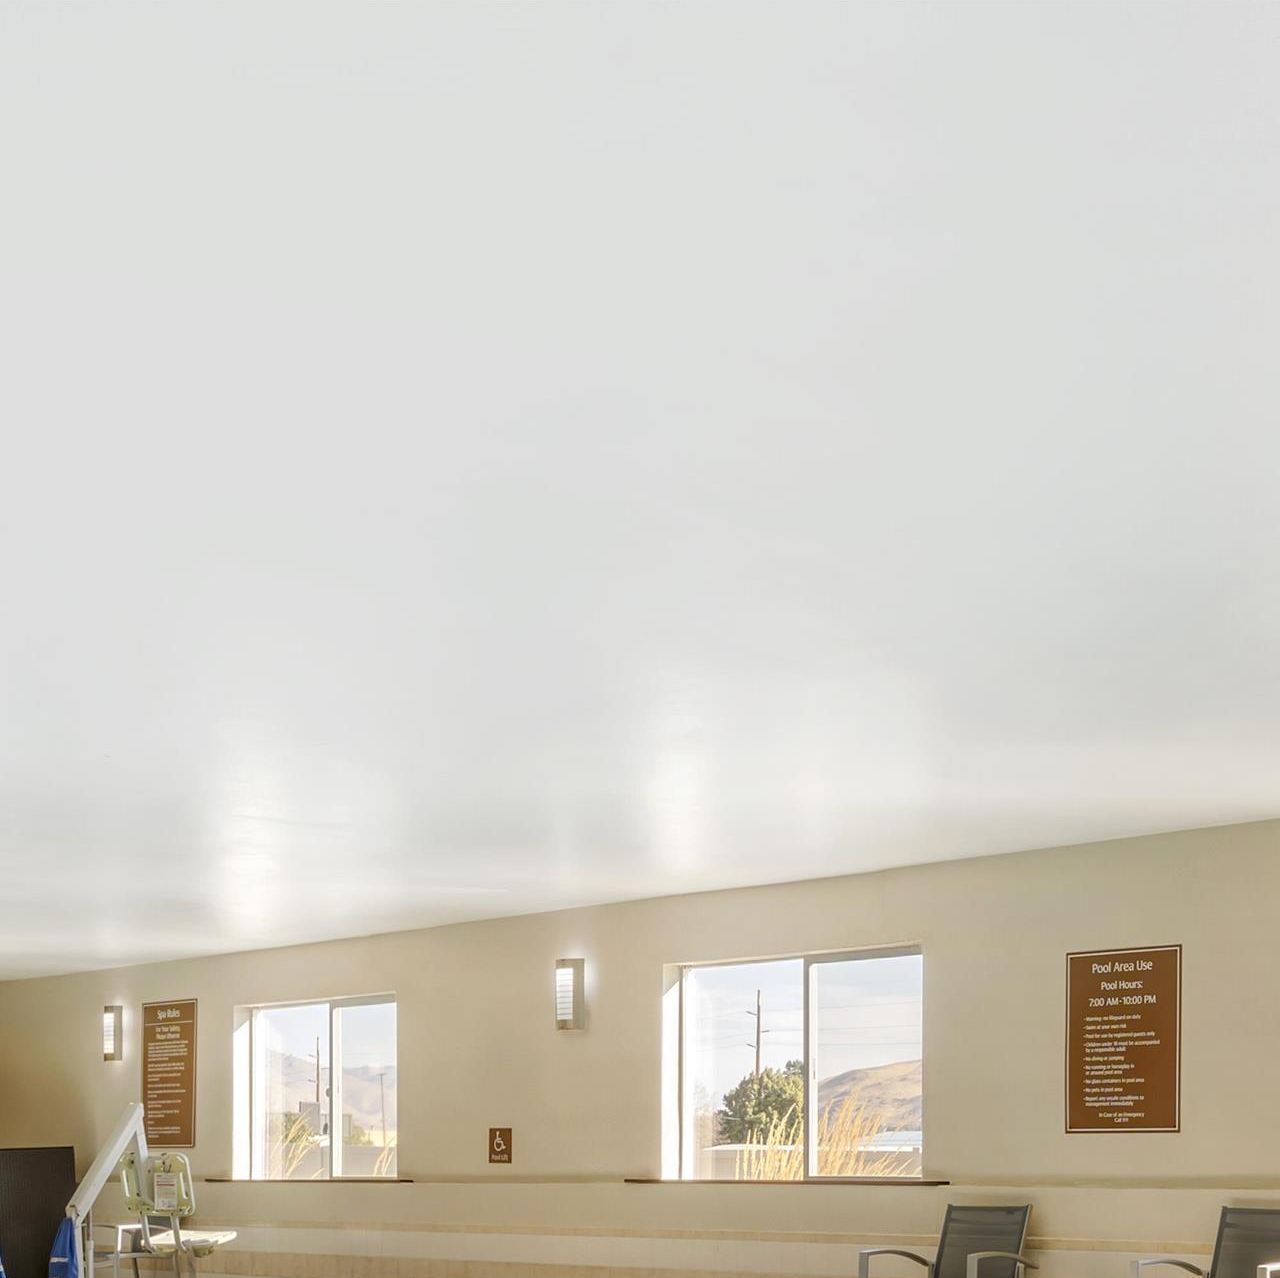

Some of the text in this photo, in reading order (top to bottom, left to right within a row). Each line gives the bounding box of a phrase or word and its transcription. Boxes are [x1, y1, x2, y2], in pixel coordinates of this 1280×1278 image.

[1092, 960, 1153, 974] Pool Area Use
[1101, 980, 1117, 991] Pool
[1144, 994, 1156, 1003] PM
